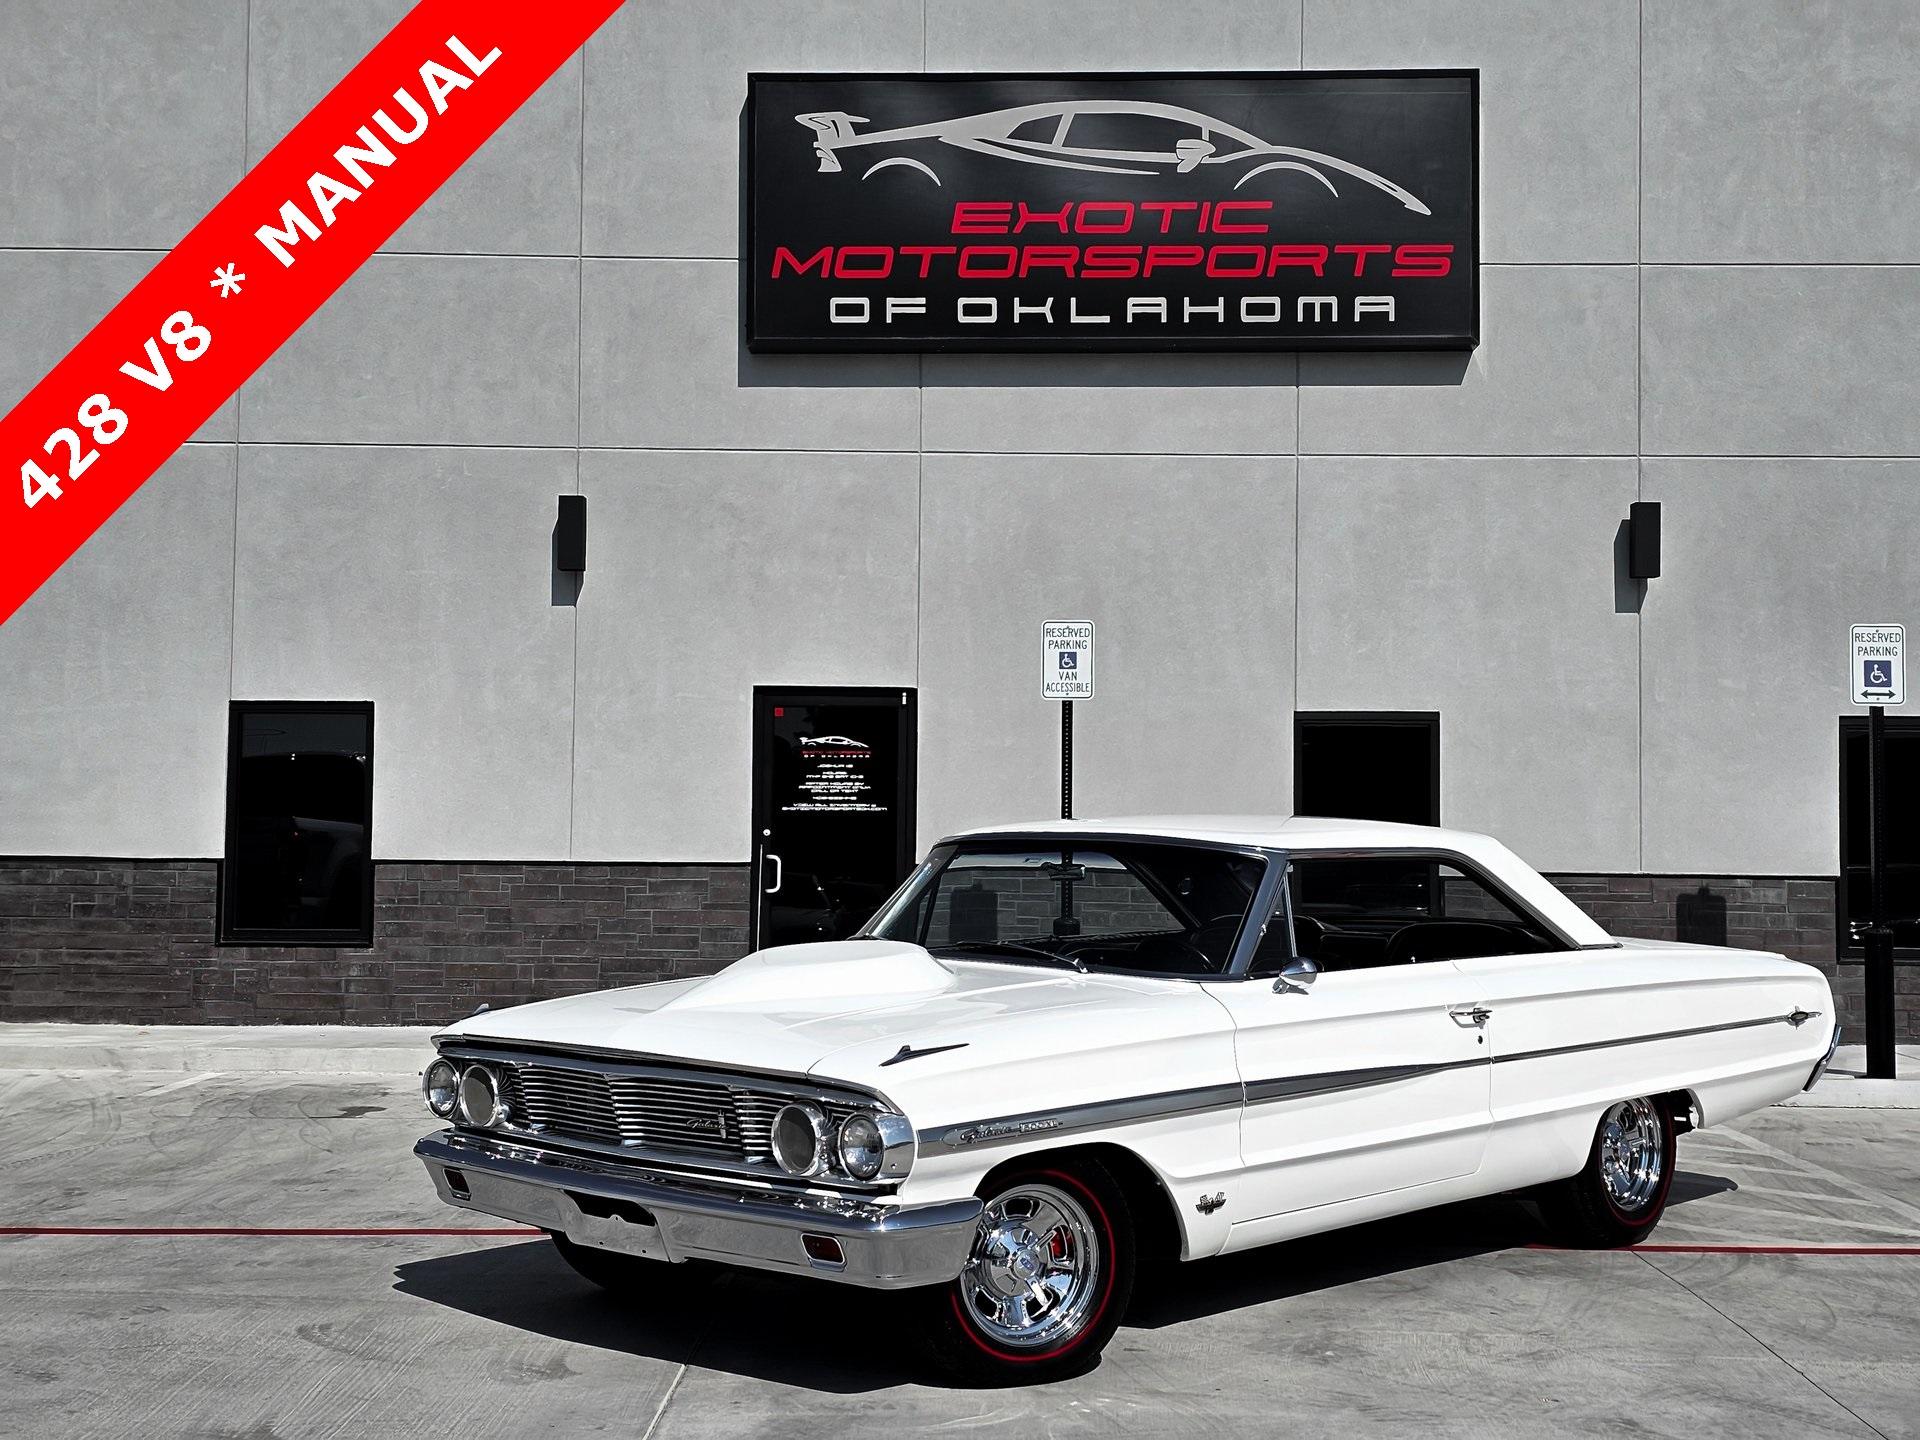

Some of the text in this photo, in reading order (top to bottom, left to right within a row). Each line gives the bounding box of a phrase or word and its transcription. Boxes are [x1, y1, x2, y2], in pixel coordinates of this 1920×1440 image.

[951, 200, 1274, 234] EXOTIC
[771, 244, 1454, 279] MOTORSPORTS
[829, 295, 1396, 325] OF OKLAHOMA
[1045, 627, 1091, 638] RESERVED
[1854, 632, 1902, 643] RESERVED
[1048, 640, 1088, 650] PARKING
[1857, 646, 1898, 657] PARKING
[1058, 671, 1078, 681] VAN
[1045, 682, 1090, 693] ACCESSIBLE
